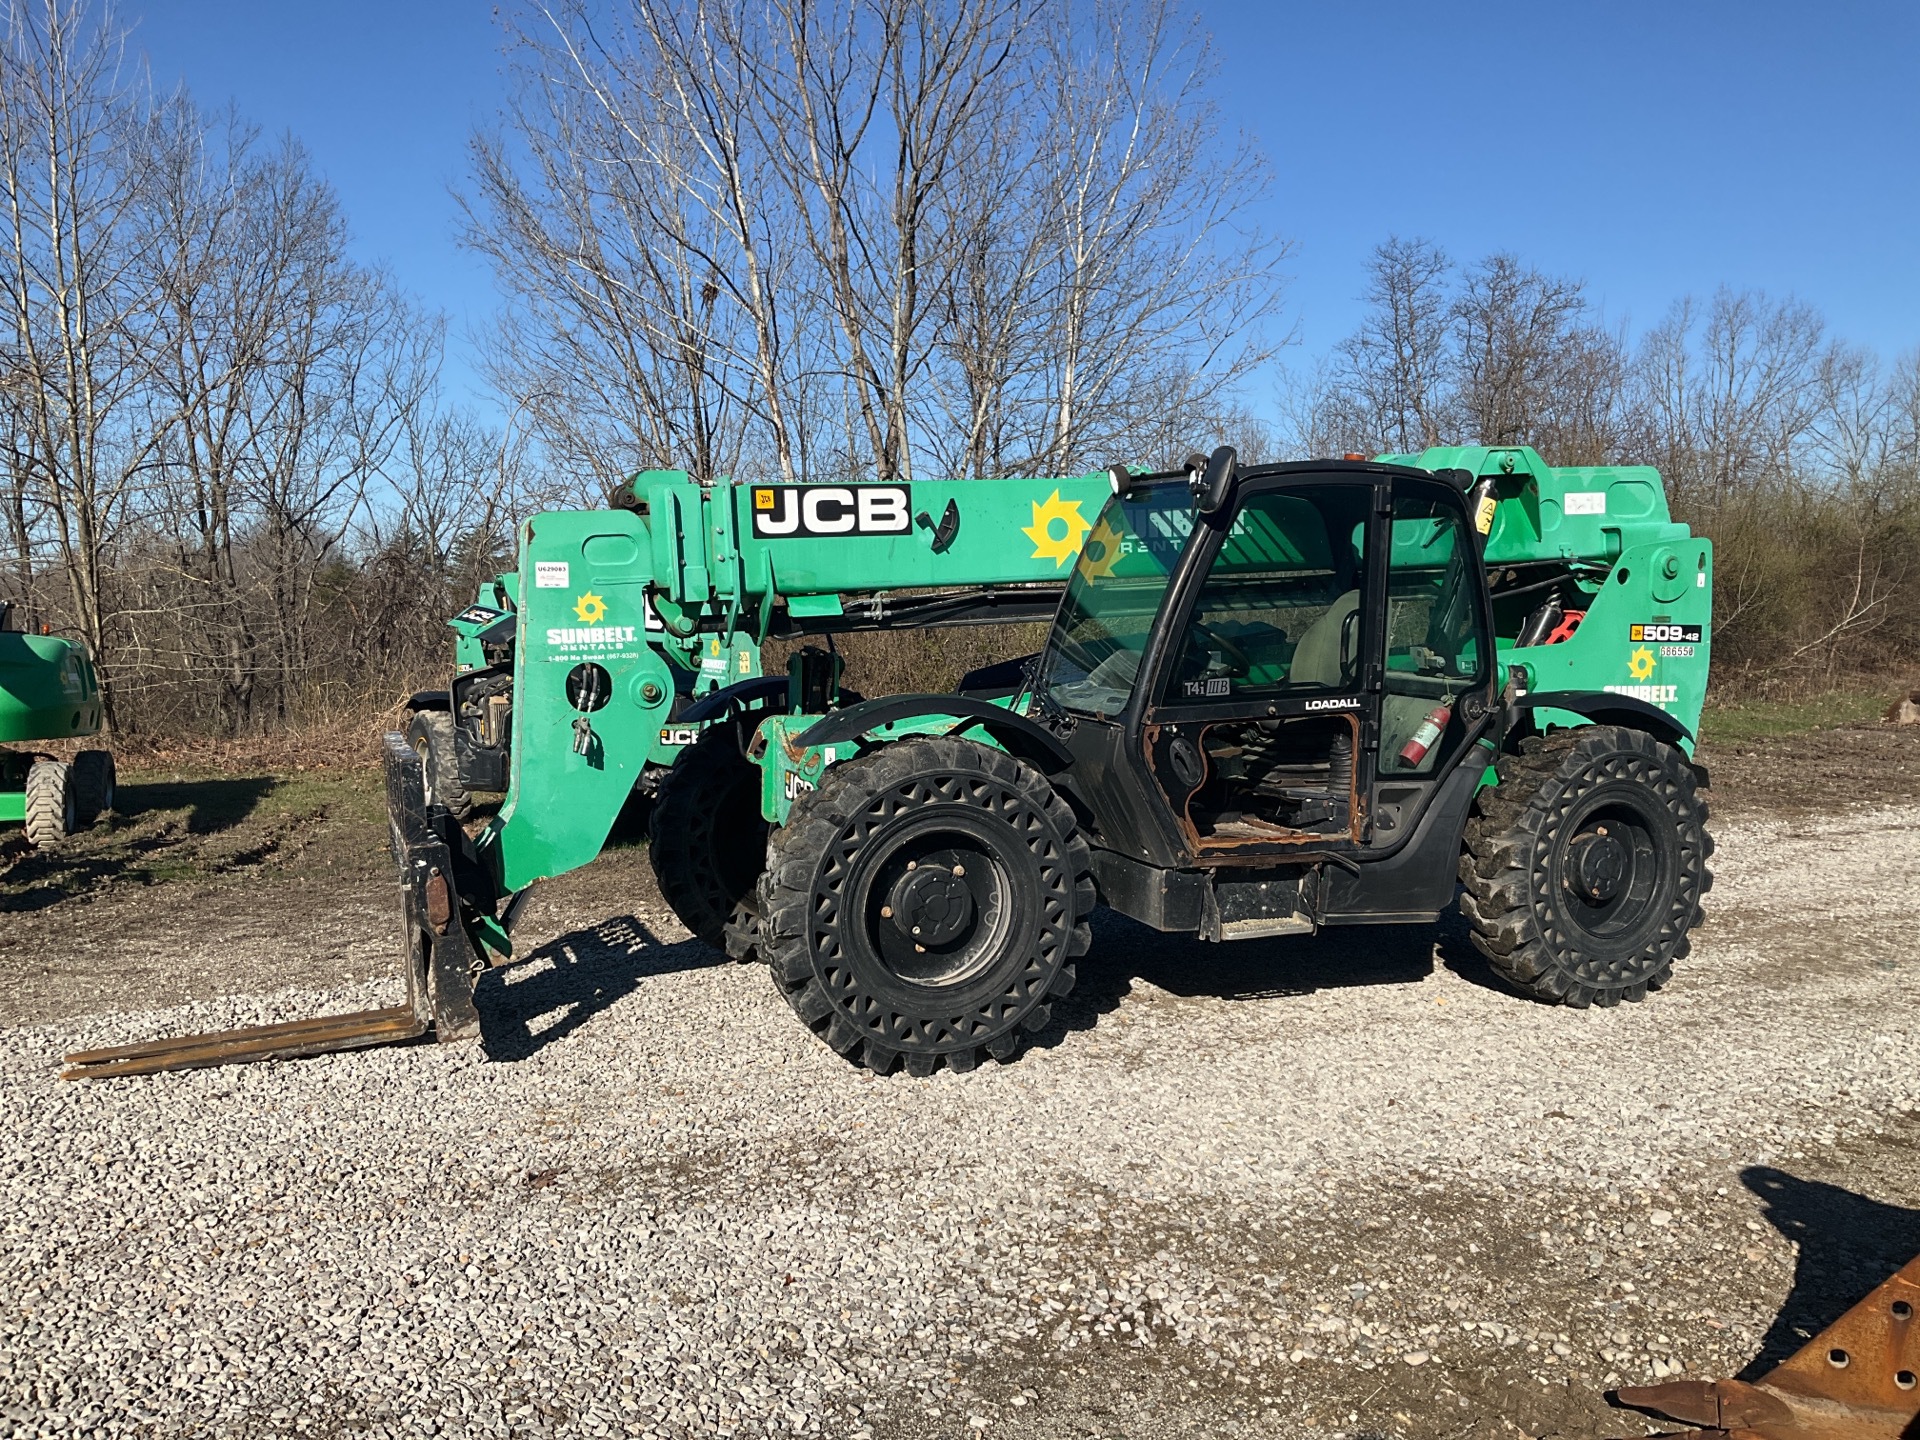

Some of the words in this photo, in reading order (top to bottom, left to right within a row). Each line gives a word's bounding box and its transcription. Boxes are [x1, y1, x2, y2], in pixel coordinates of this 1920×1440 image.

[756, 488, 909, 534] JCB
[1120, 539, 1228, 553] RENT
[546, 626, 635, 645] SUNBELT
[560, 642, 624, 652] RENTALS
[1184, 681, 1205, 696] T4i
[1305, 698, 1361, 710] LOADALL
